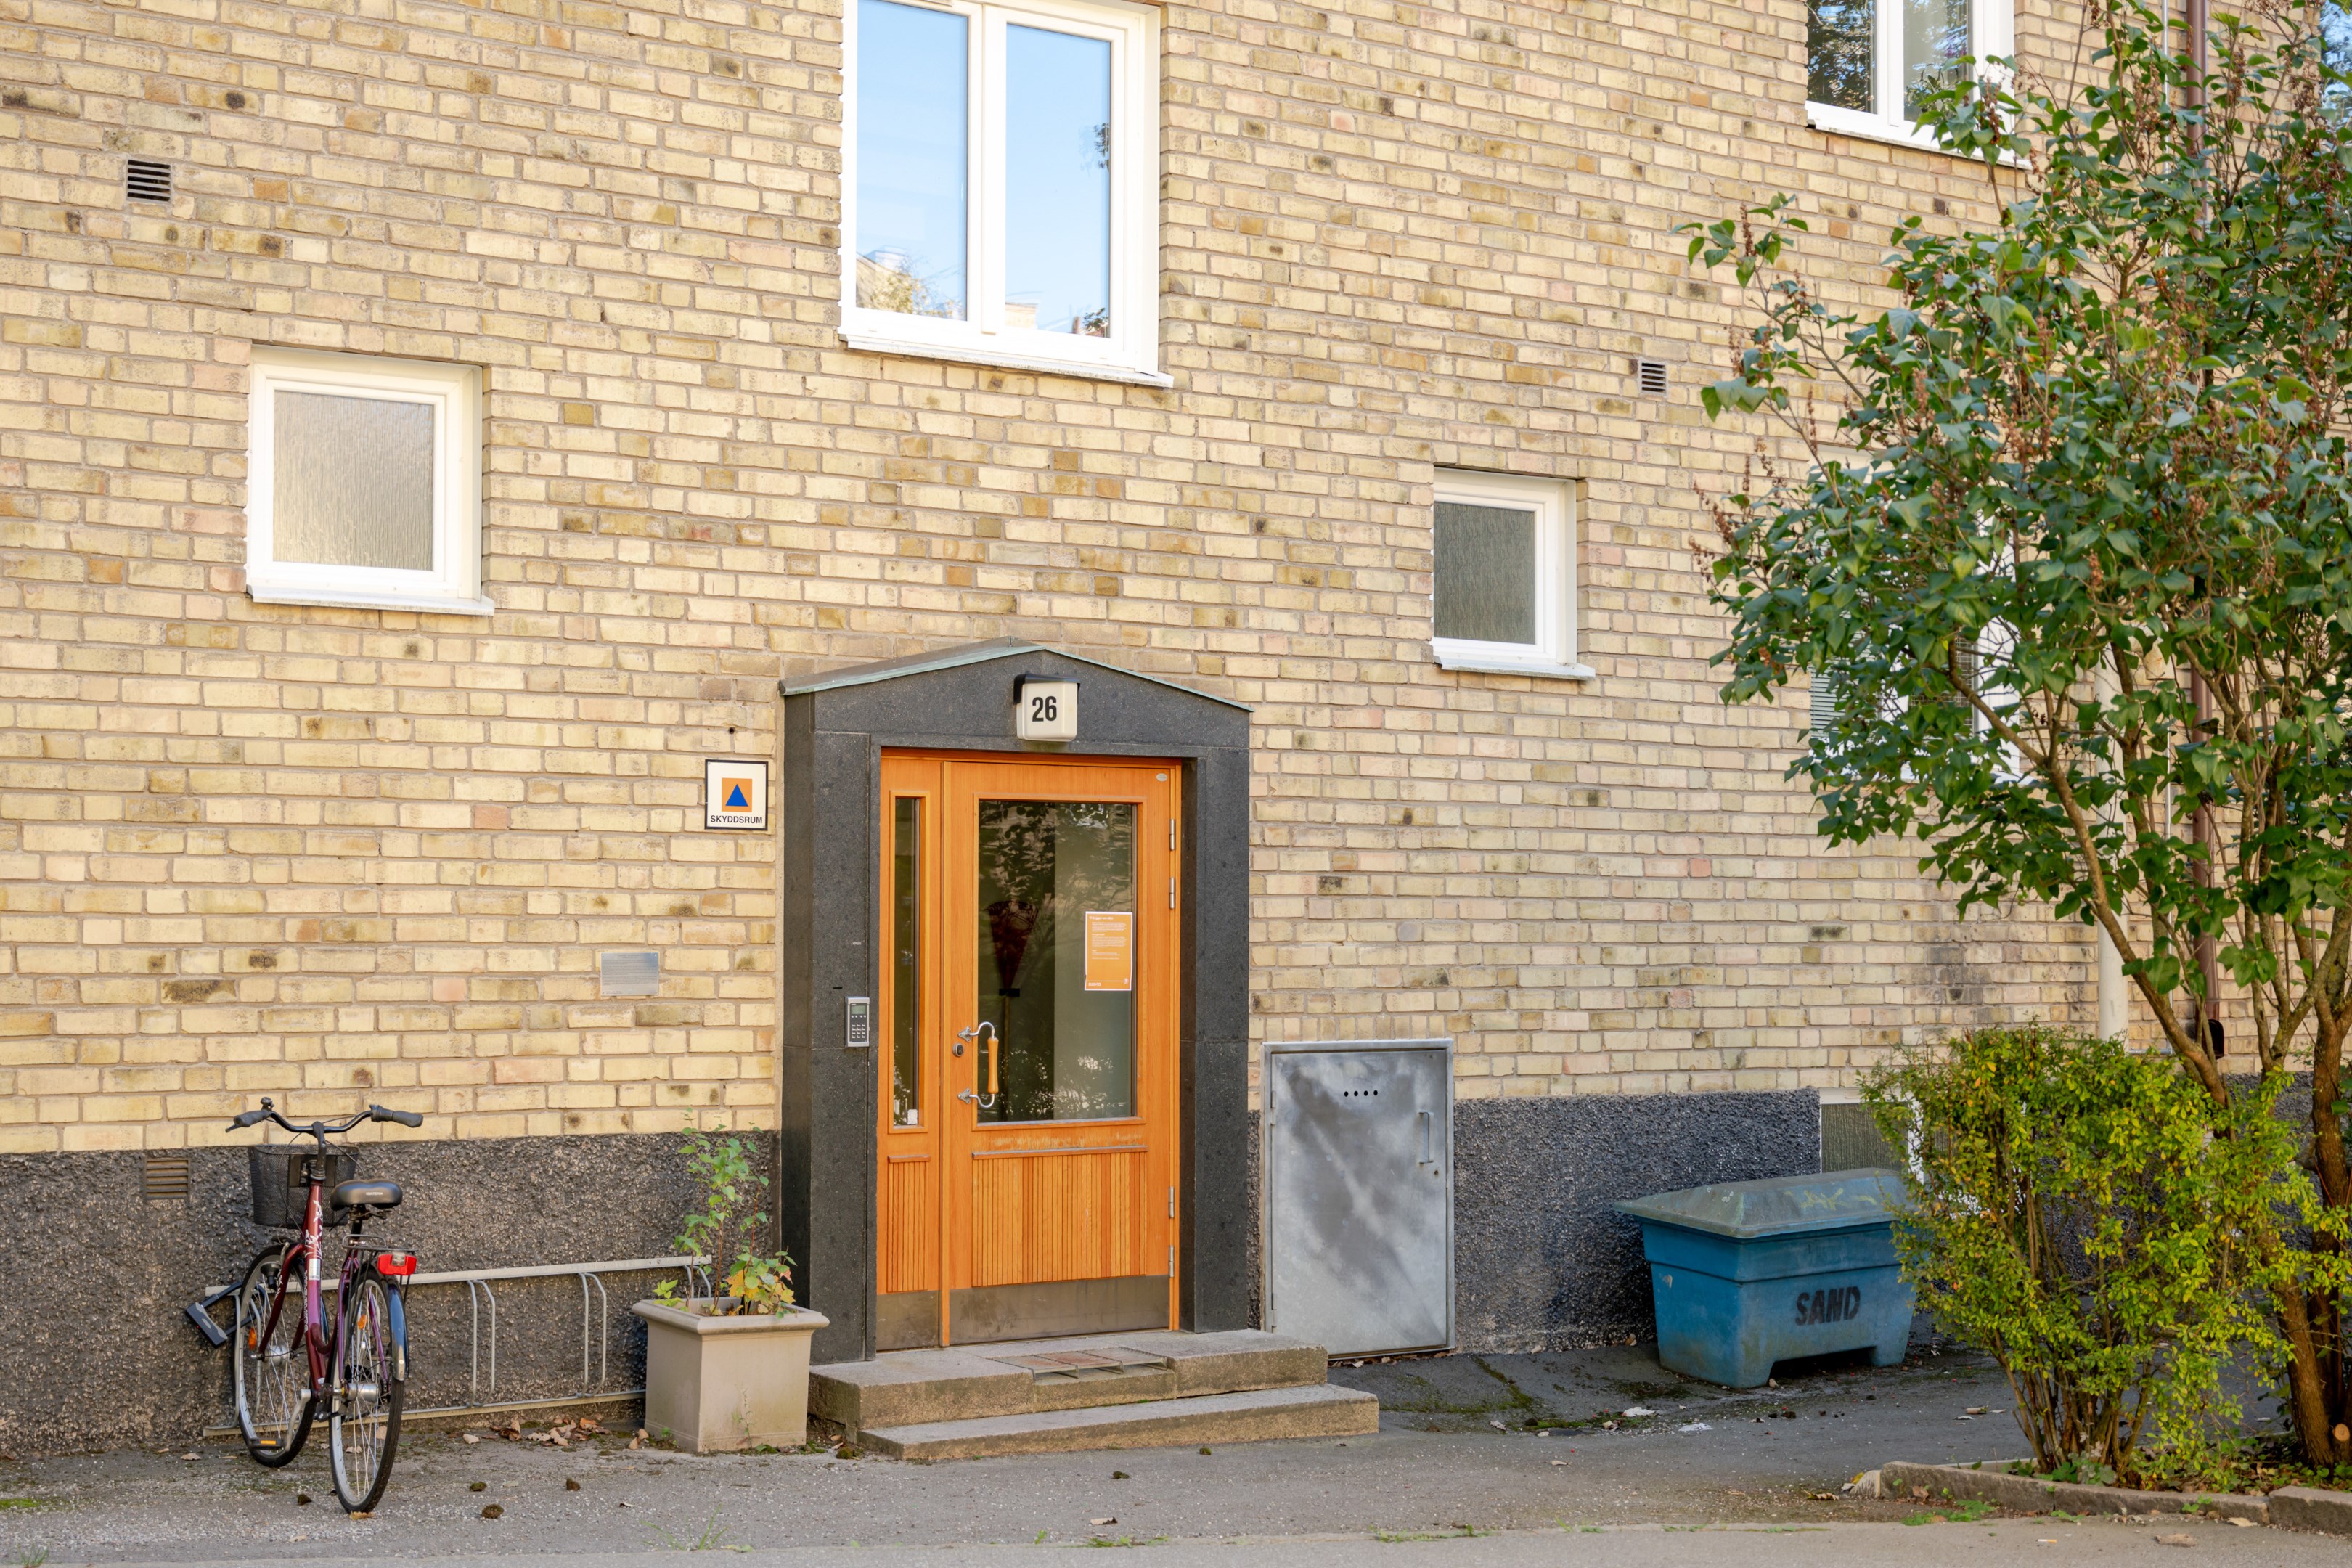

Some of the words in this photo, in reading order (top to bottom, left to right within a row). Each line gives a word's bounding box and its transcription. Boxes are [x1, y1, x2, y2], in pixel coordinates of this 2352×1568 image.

[1032, 696, 1057, 722] 26
[710, 814, 763, 824] SKYDDSRUM
[1795, 1286, 1861, 1326] SAND
